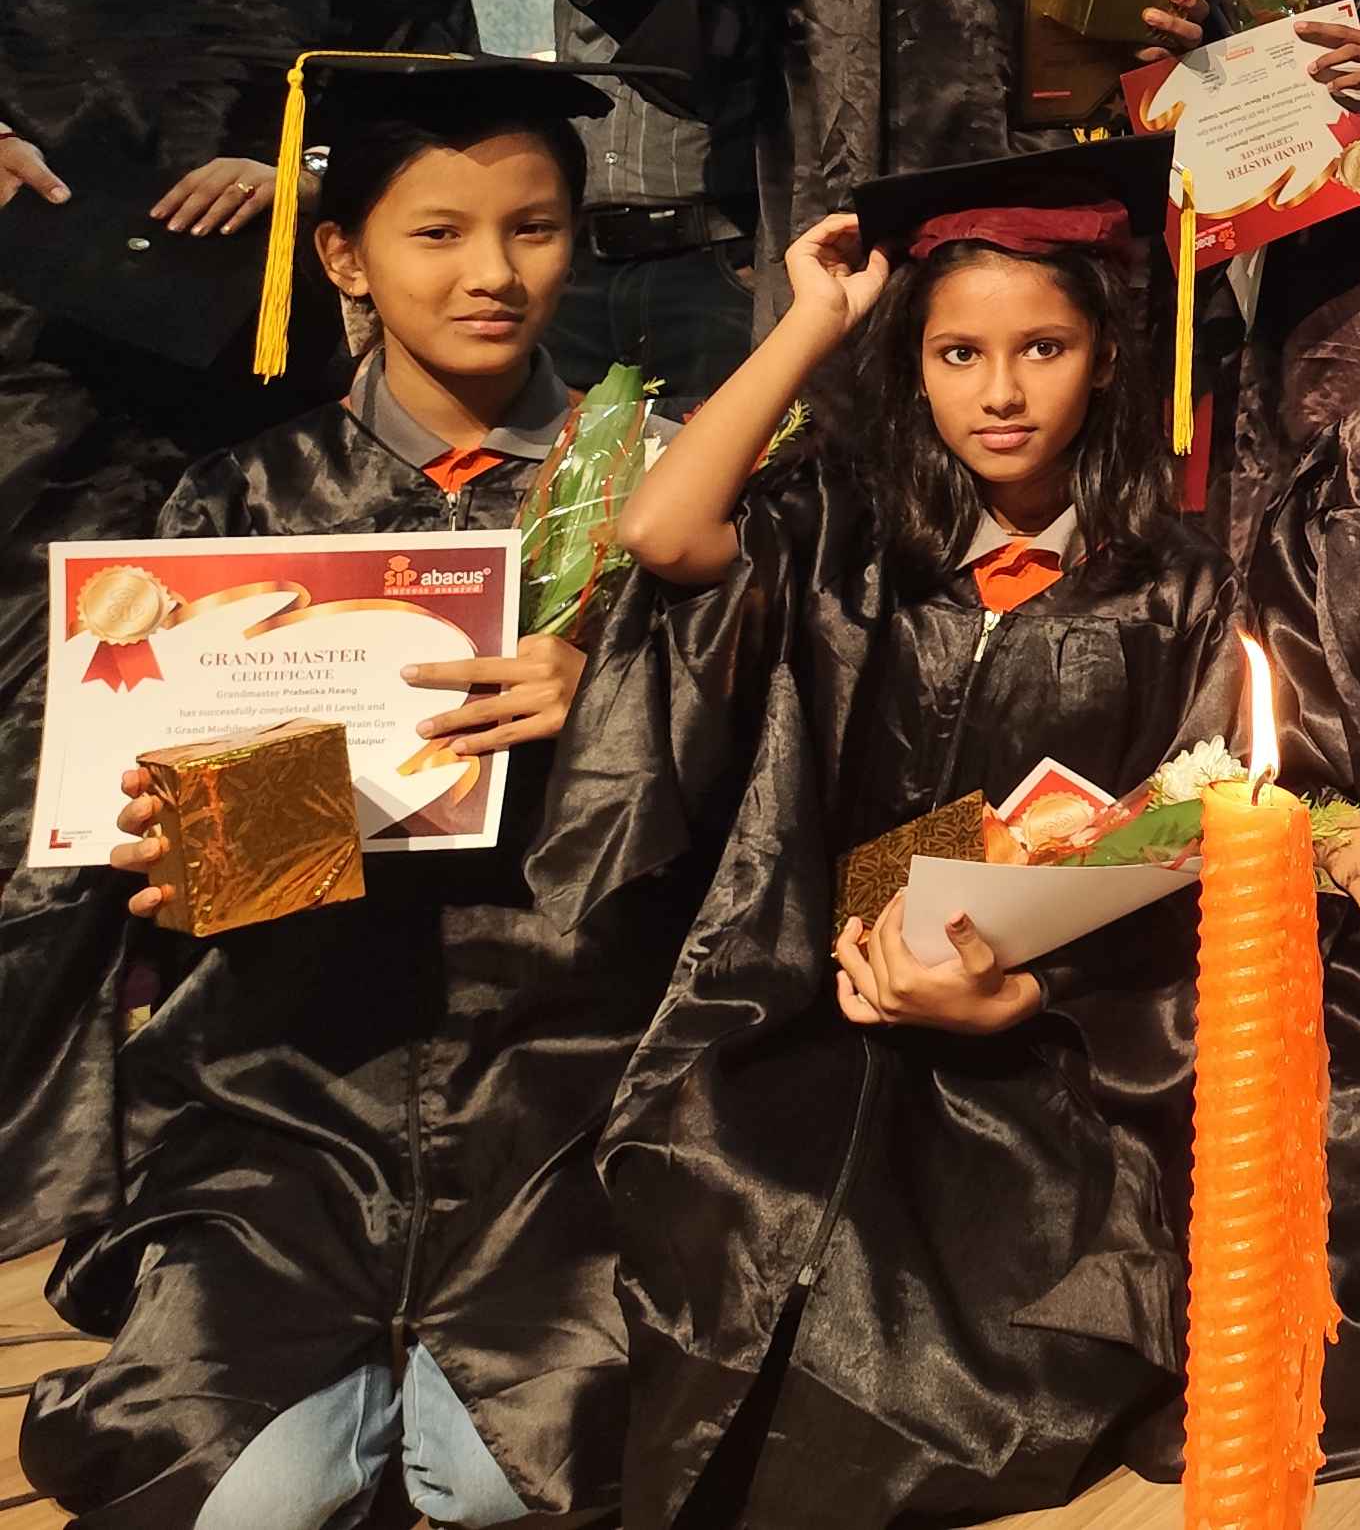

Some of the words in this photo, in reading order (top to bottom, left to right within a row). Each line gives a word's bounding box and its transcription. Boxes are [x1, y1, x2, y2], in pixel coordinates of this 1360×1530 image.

[420, 567, 485, 586] abacus
[200, 651, 275, 668] GRAND
[283, 648, 367, 665] MASTER
[231, 669, 335, 683] CERTIFICATE
[216, 689, 280, 700] Grandmaster
